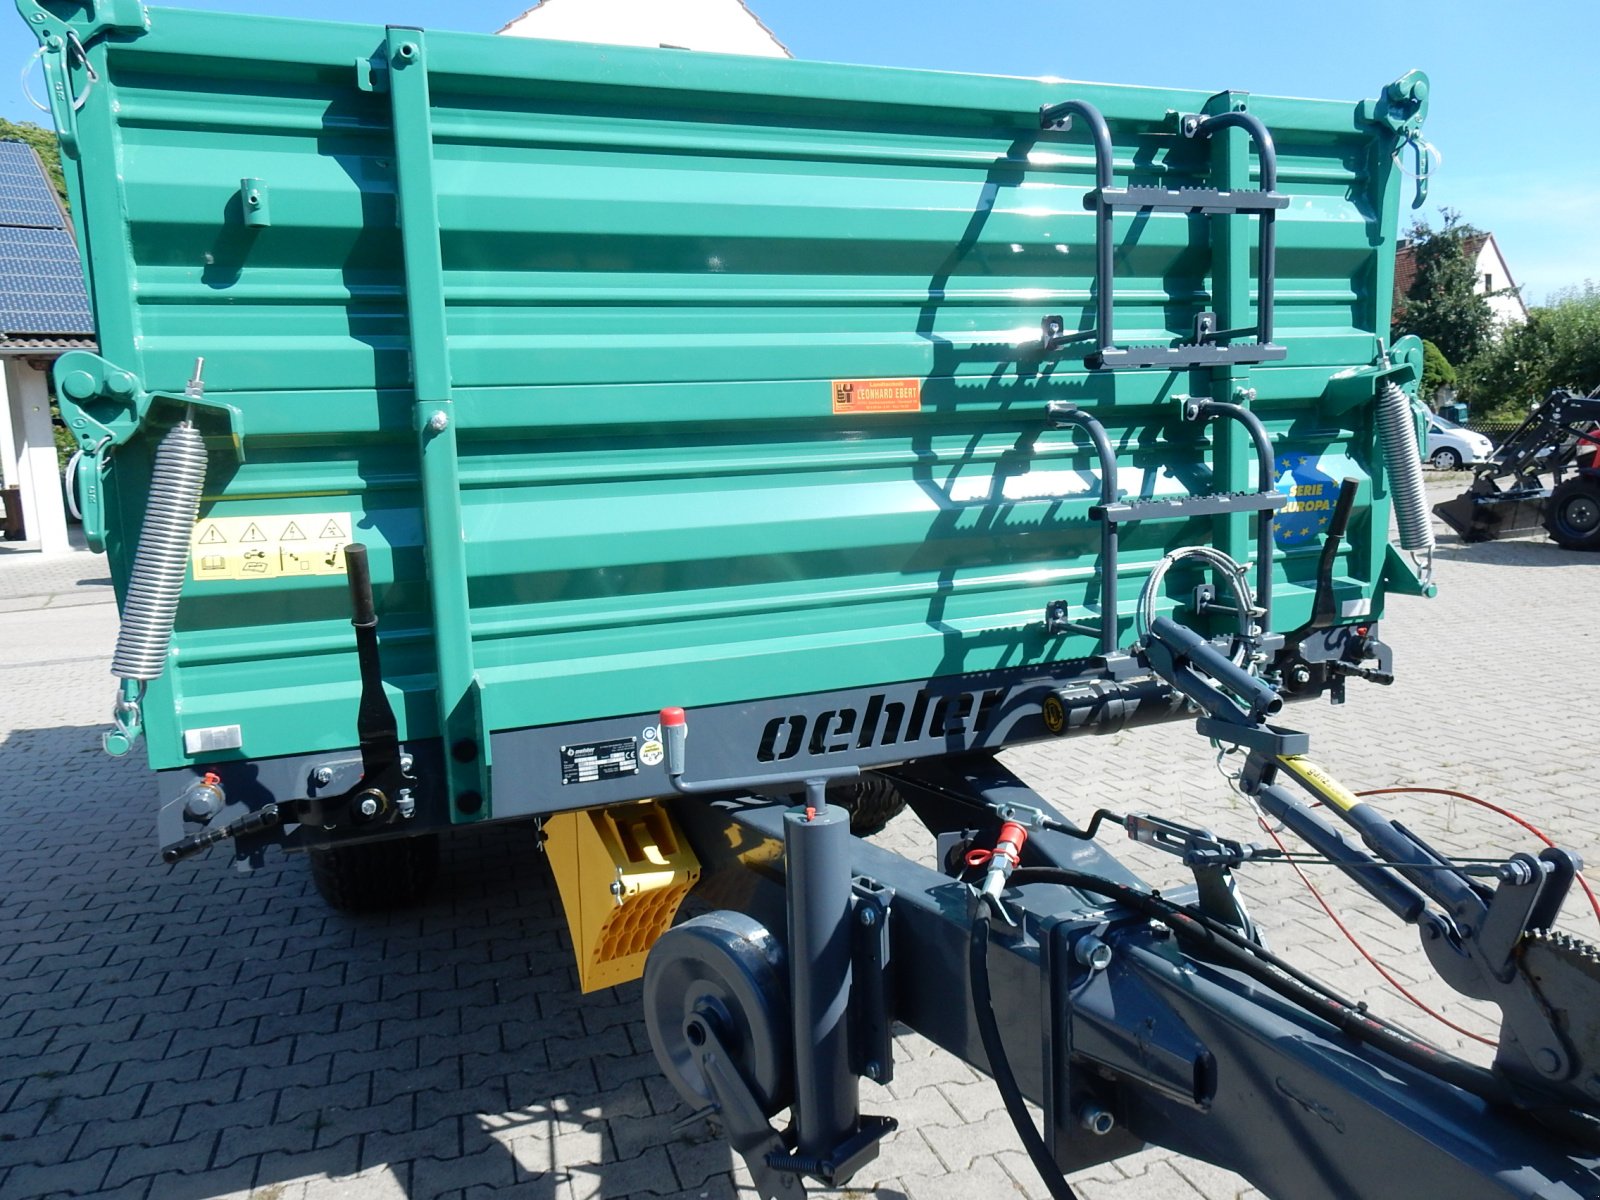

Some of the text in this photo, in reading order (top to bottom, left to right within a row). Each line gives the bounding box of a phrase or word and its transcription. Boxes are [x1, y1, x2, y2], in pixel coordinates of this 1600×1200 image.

[857, 388, 893, 400] LEONHARD
[896, 387, 917, 399] EBERT
[1289, 484, 1323, 497] SERIE
[756, 688, 1006, 764] oehler
